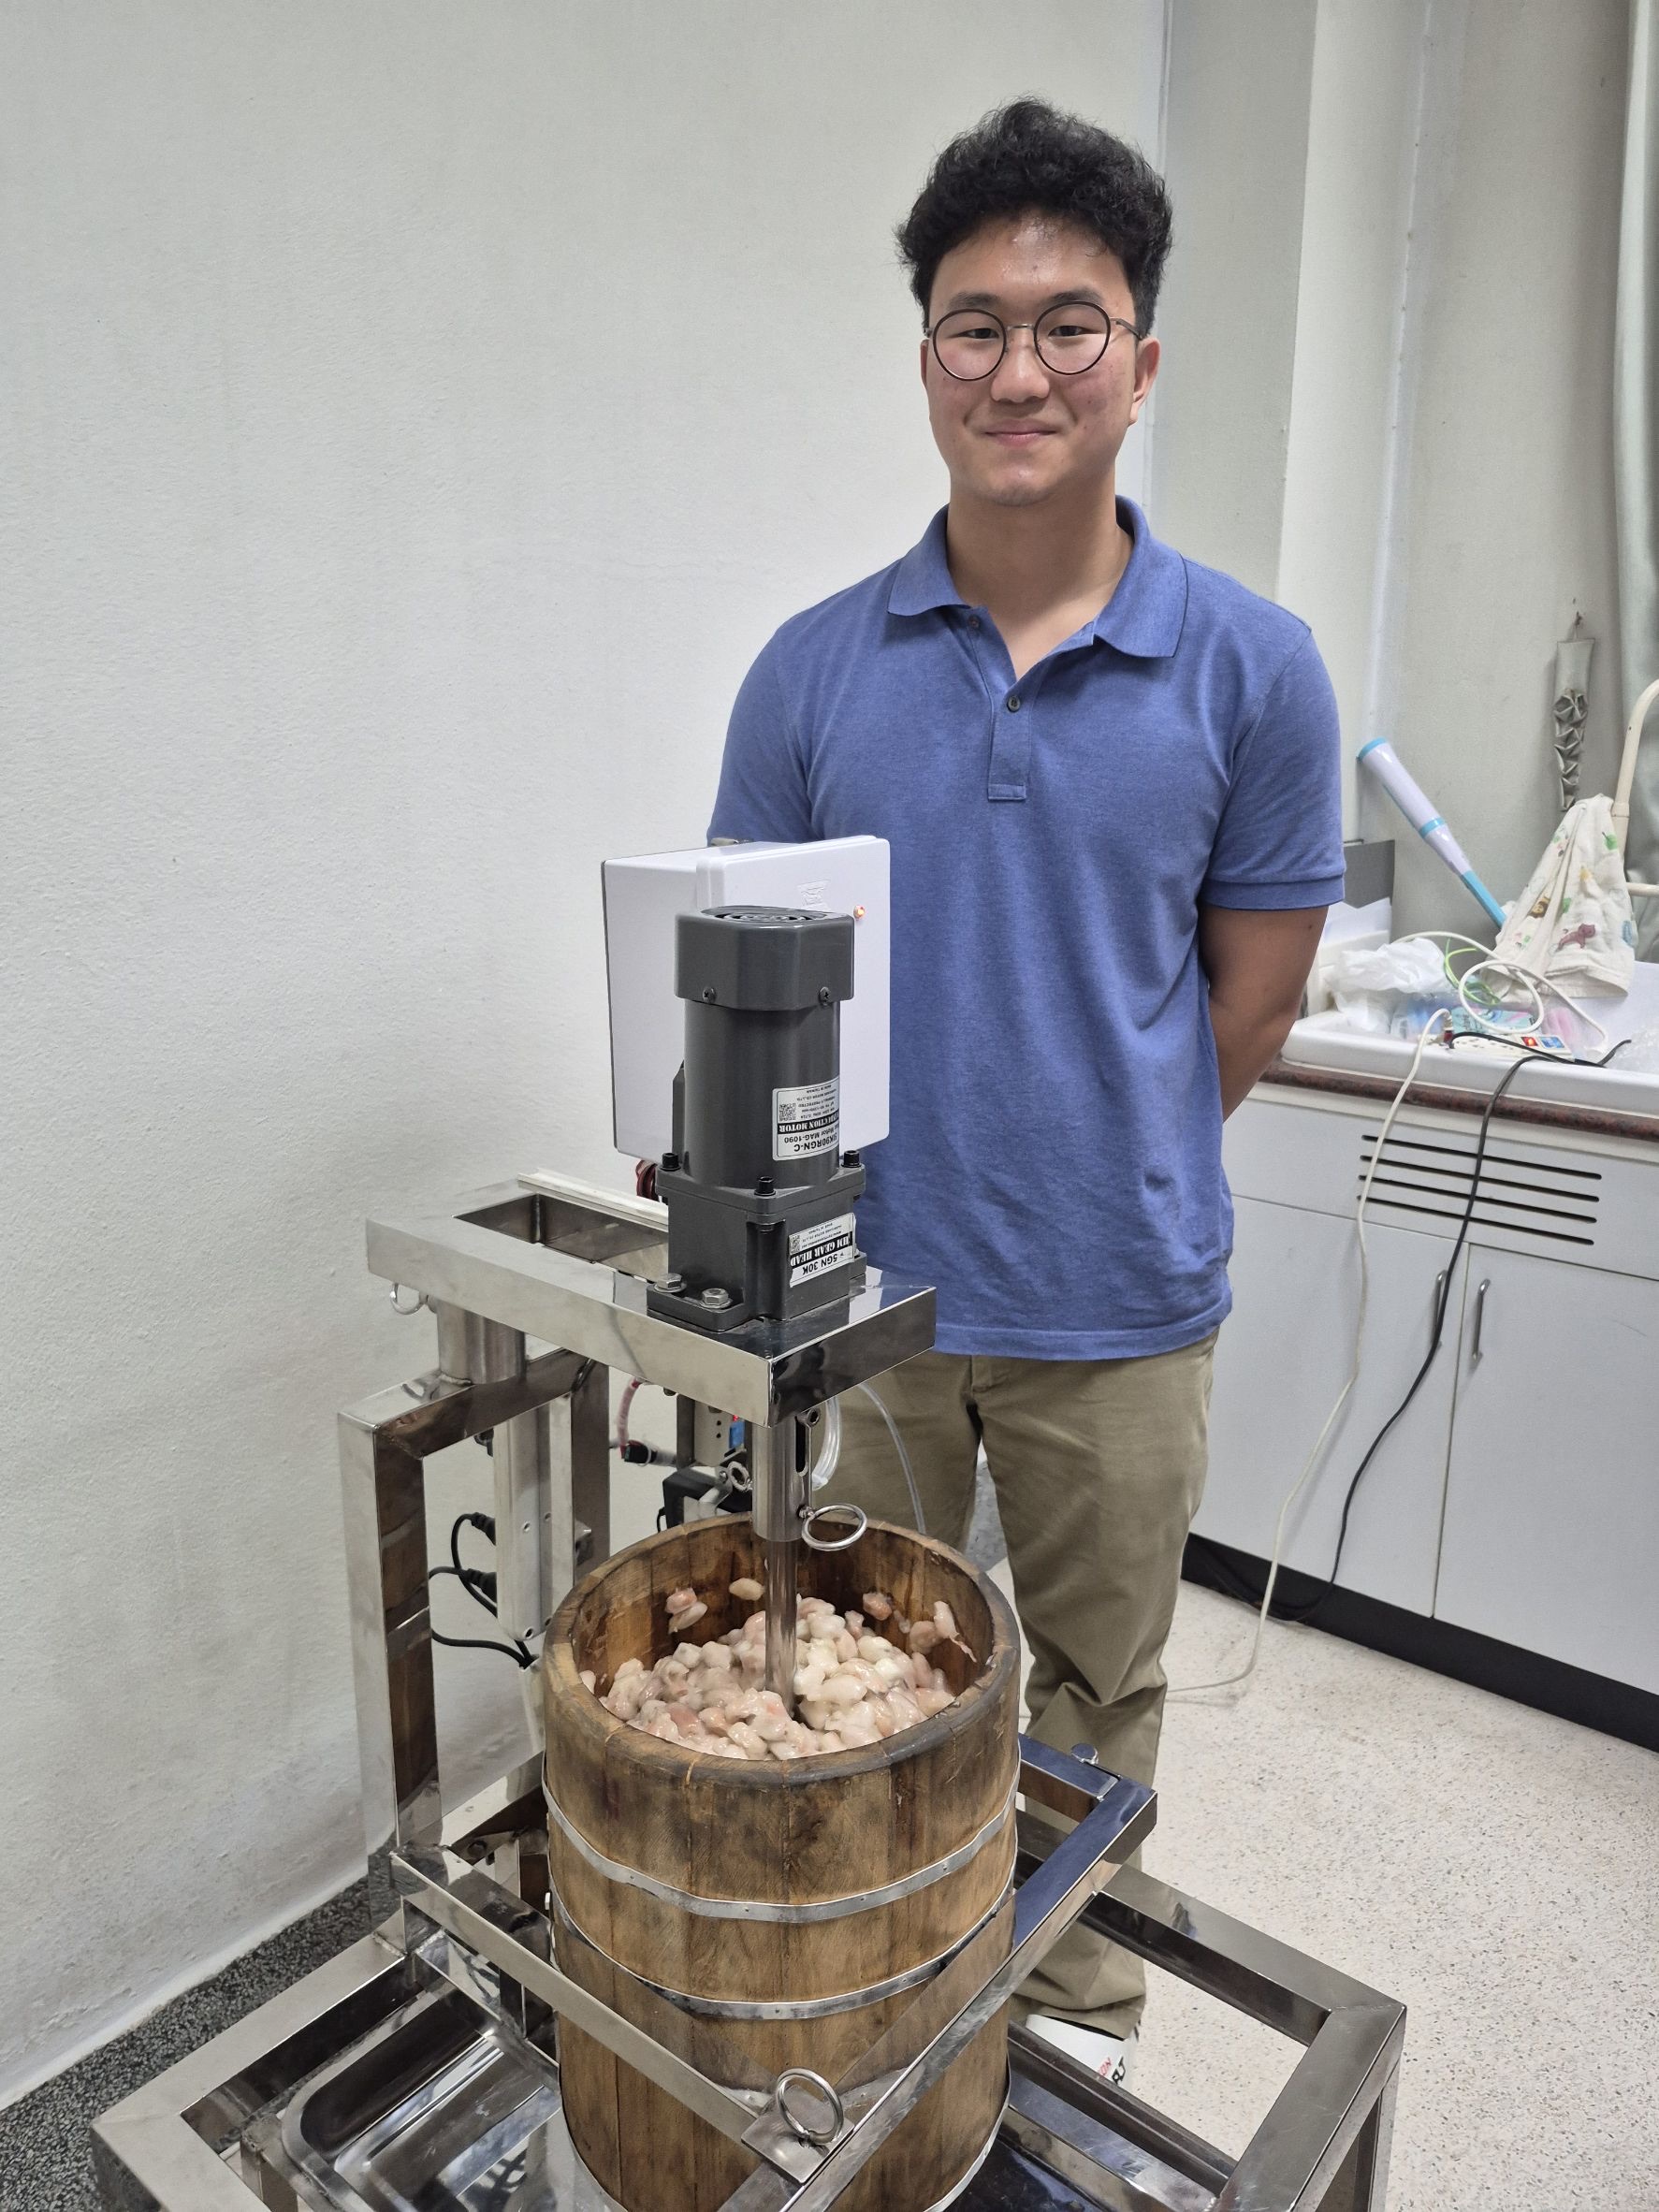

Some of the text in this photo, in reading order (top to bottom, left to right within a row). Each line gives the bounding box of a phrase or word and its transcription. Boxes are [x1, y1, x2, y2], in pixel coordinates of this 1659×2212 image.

[779, 1124, 808, 1132] MOTOR
[784, 1132, 820, 1143] MAG-1090
[814, 1242, 836, 1257] GEAR
[790, 1250, 812, 1266] HEAD
[802, 1254, 837, 1274] 5GN 30K
